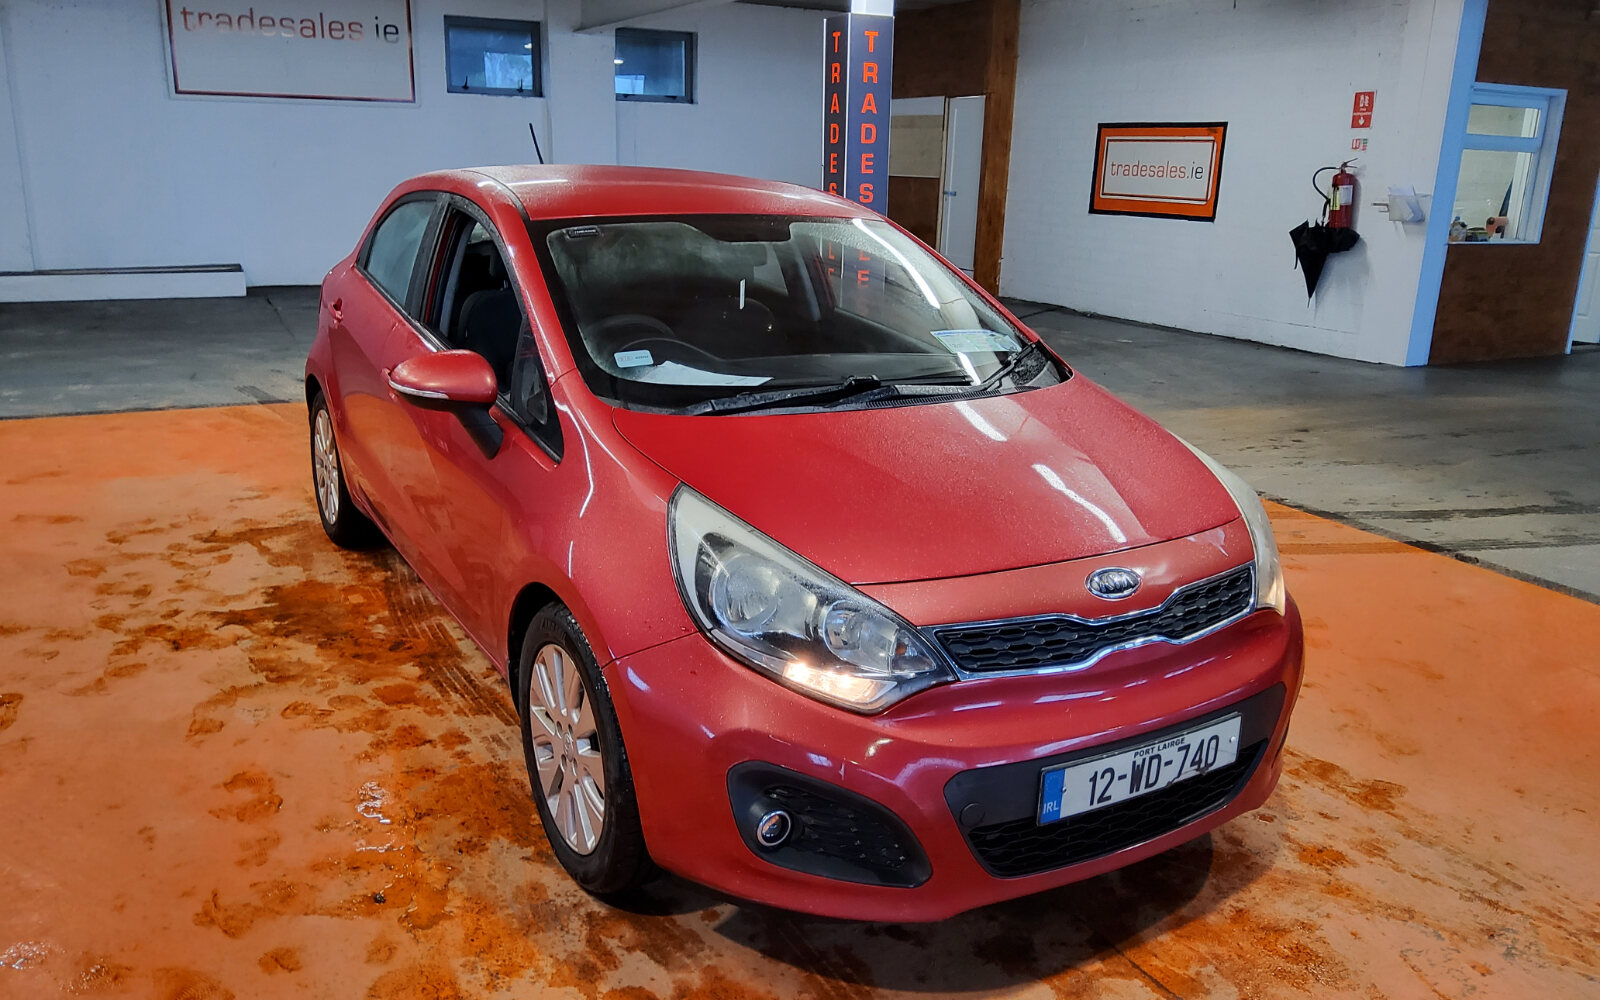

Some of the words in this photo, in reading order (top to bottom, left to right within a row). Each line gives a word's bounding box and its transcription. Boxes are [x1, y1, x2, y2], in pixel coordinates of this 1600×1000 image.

[859, 30, 879, 203] TRADES
[1110, 160, 1204, 180] tradesales.ie
[1133, 747, 1155, 758] PORT
[1157, 737, 1185, 751] LAIRGE
[1088, 734, 1220, 807] 12-WD-740
[1043, 801, 1060, 815] IRL
